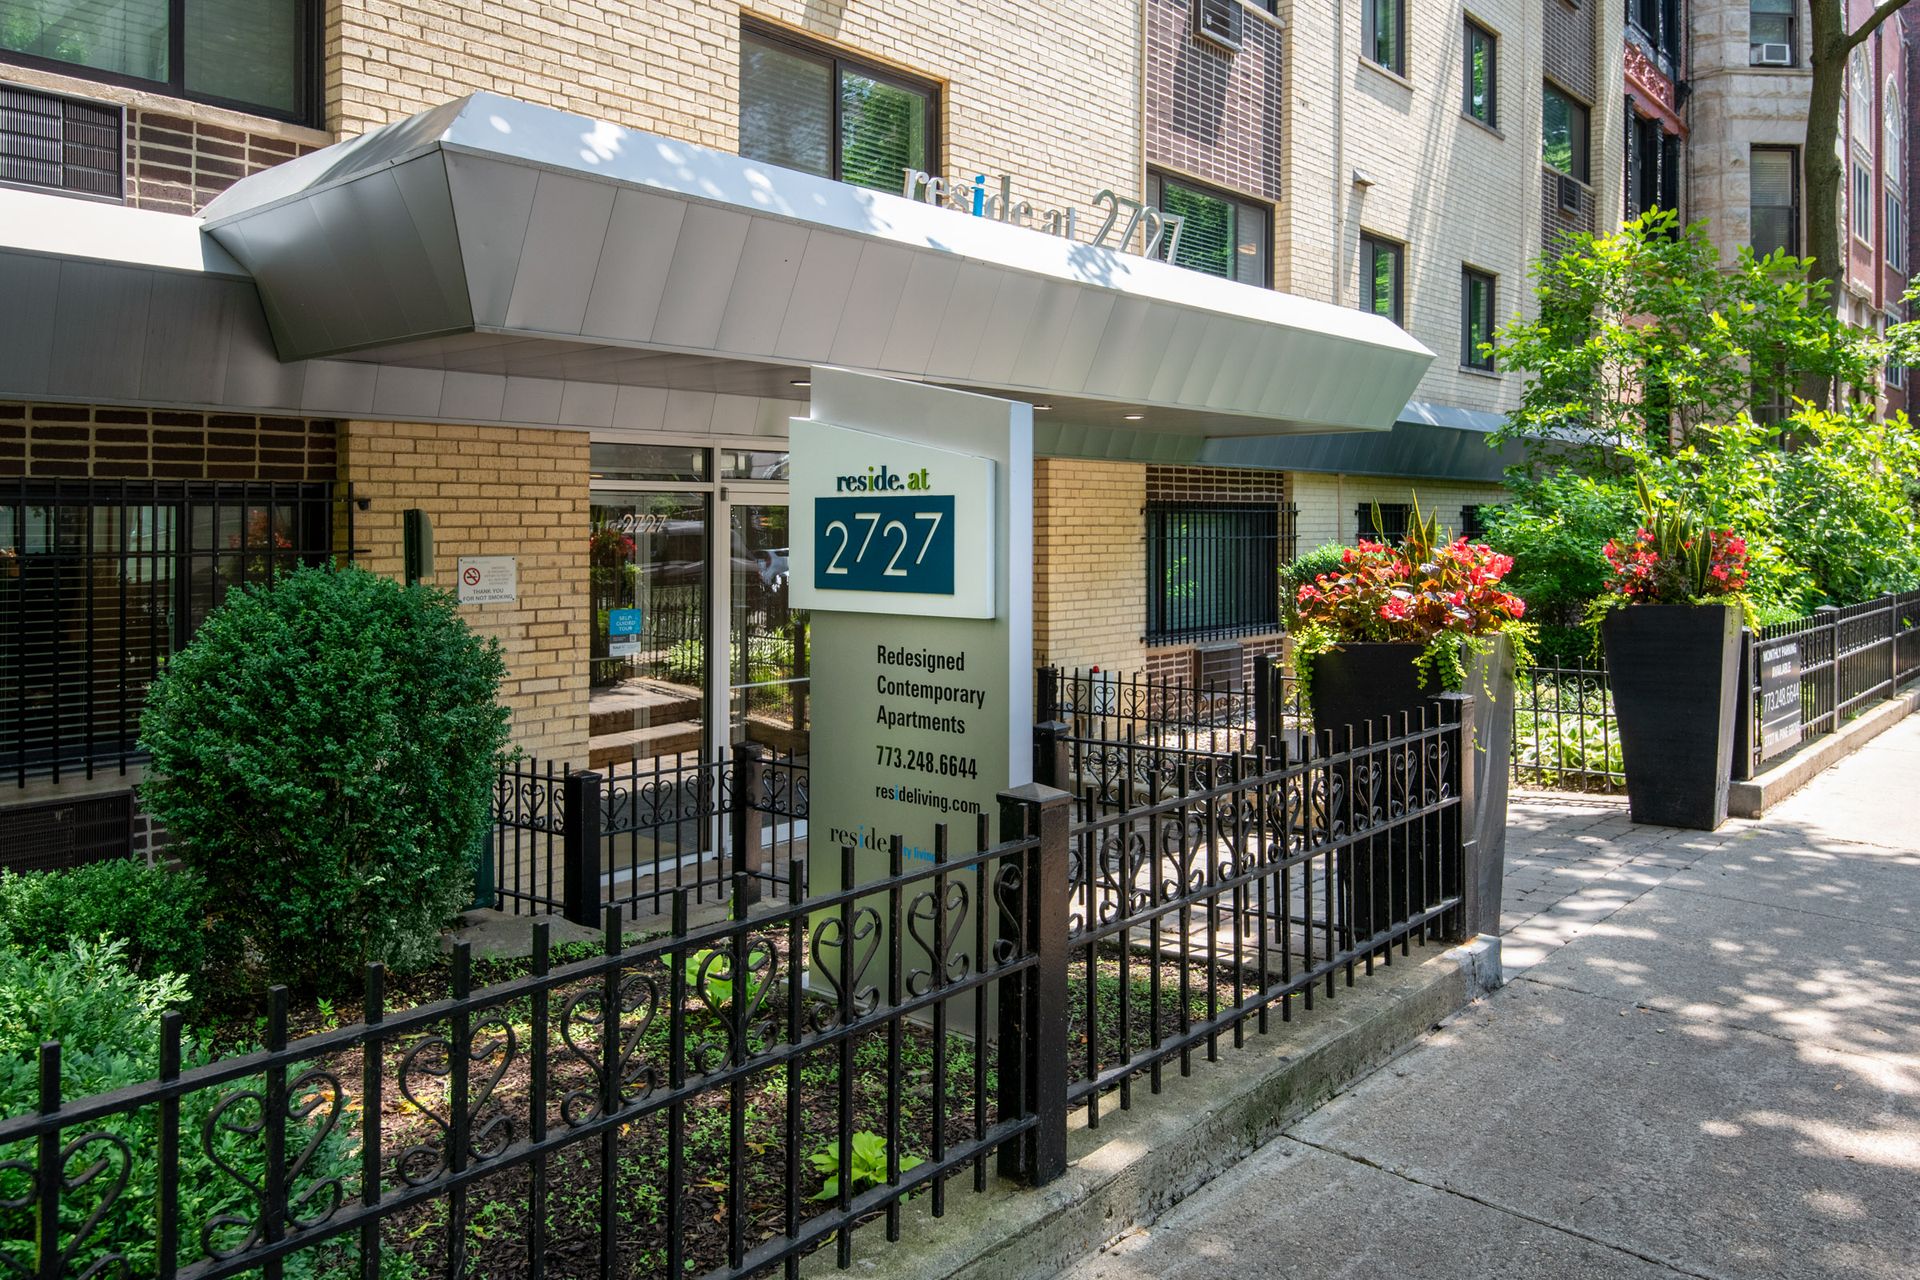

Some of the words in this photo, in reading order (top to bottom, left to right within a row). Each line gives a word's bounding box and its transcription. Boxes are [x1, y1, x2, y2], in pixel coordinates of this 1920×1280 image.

[1092, 188, 1186, 266] 2727
[836, 465, 931, 492] reside.at
[623, 513, 668, 533] 2727
[824, 512, 944, 577] 2727
[488, 593, 513, 601] SMOKING
[877, 645, 965, 673] Redesigned
[876, 675, 986, 710] Contemporary
[1763, 682, 1800, 713] 773.248.6644
[876, 705, 966, 734] Apartments
[875, 745, 978, 780] 773.248.6644
[875, 784, 981, 815] resideliving.com
